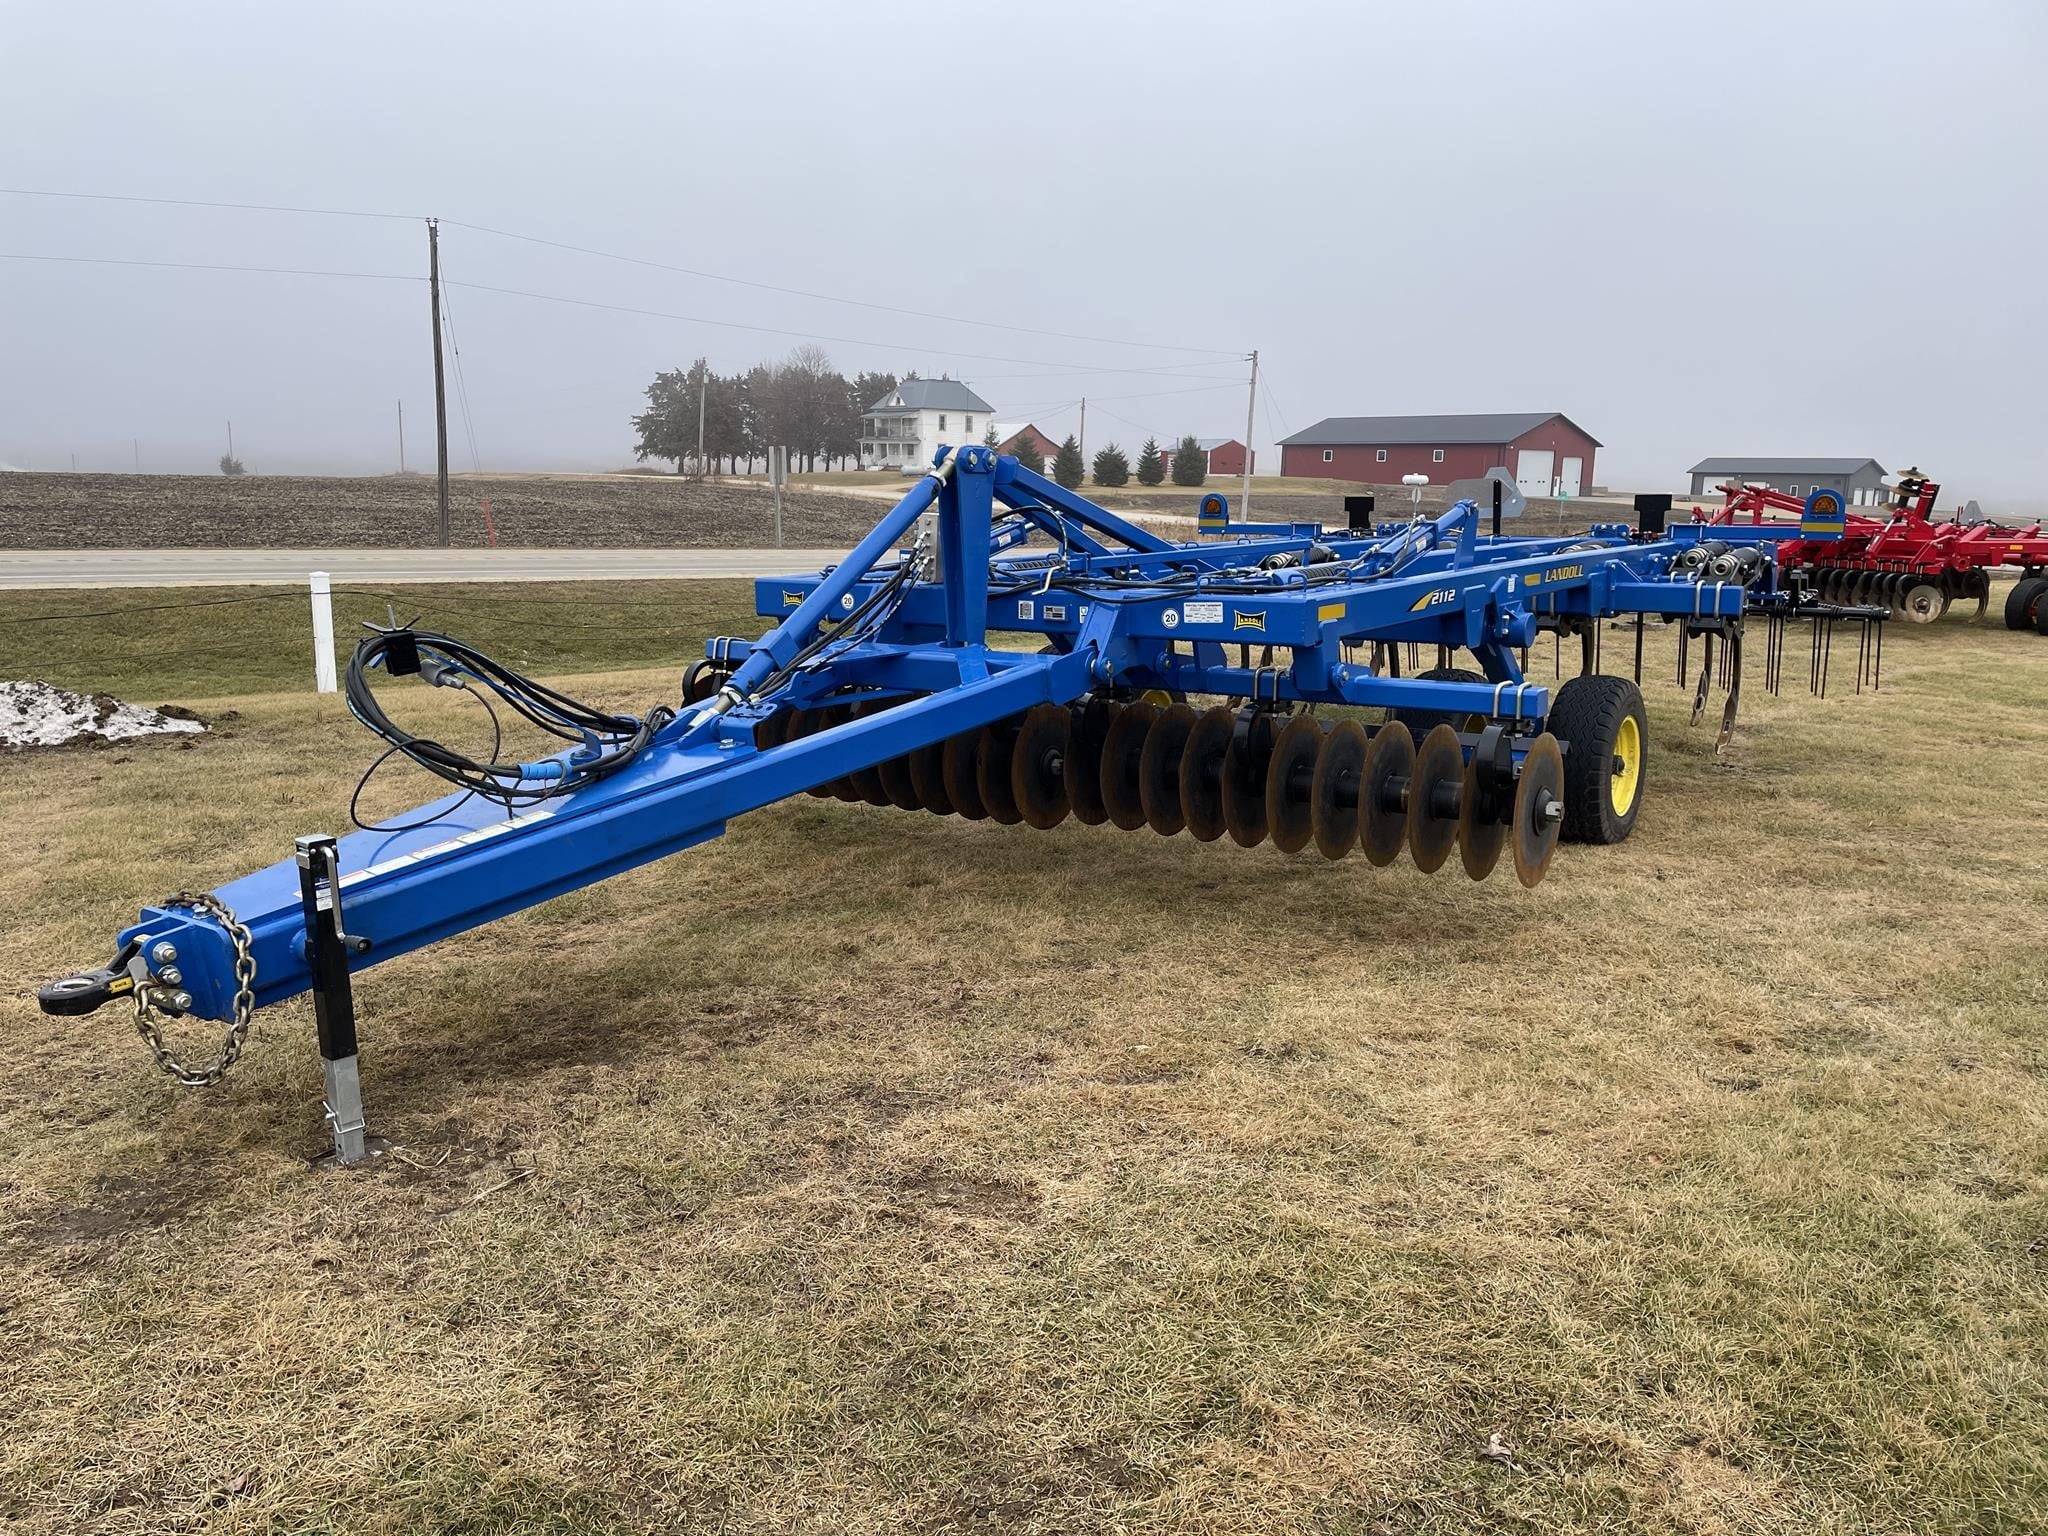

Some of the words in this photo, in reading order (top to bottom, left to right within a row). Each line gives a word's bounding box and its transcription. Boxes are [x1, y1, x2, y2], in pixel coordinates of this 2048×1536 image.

[1545, 565, 1584, 582] LANDOLL
[1432, 590, 1455, 604] 2112
[1165, 613, 1176, 623] 20
